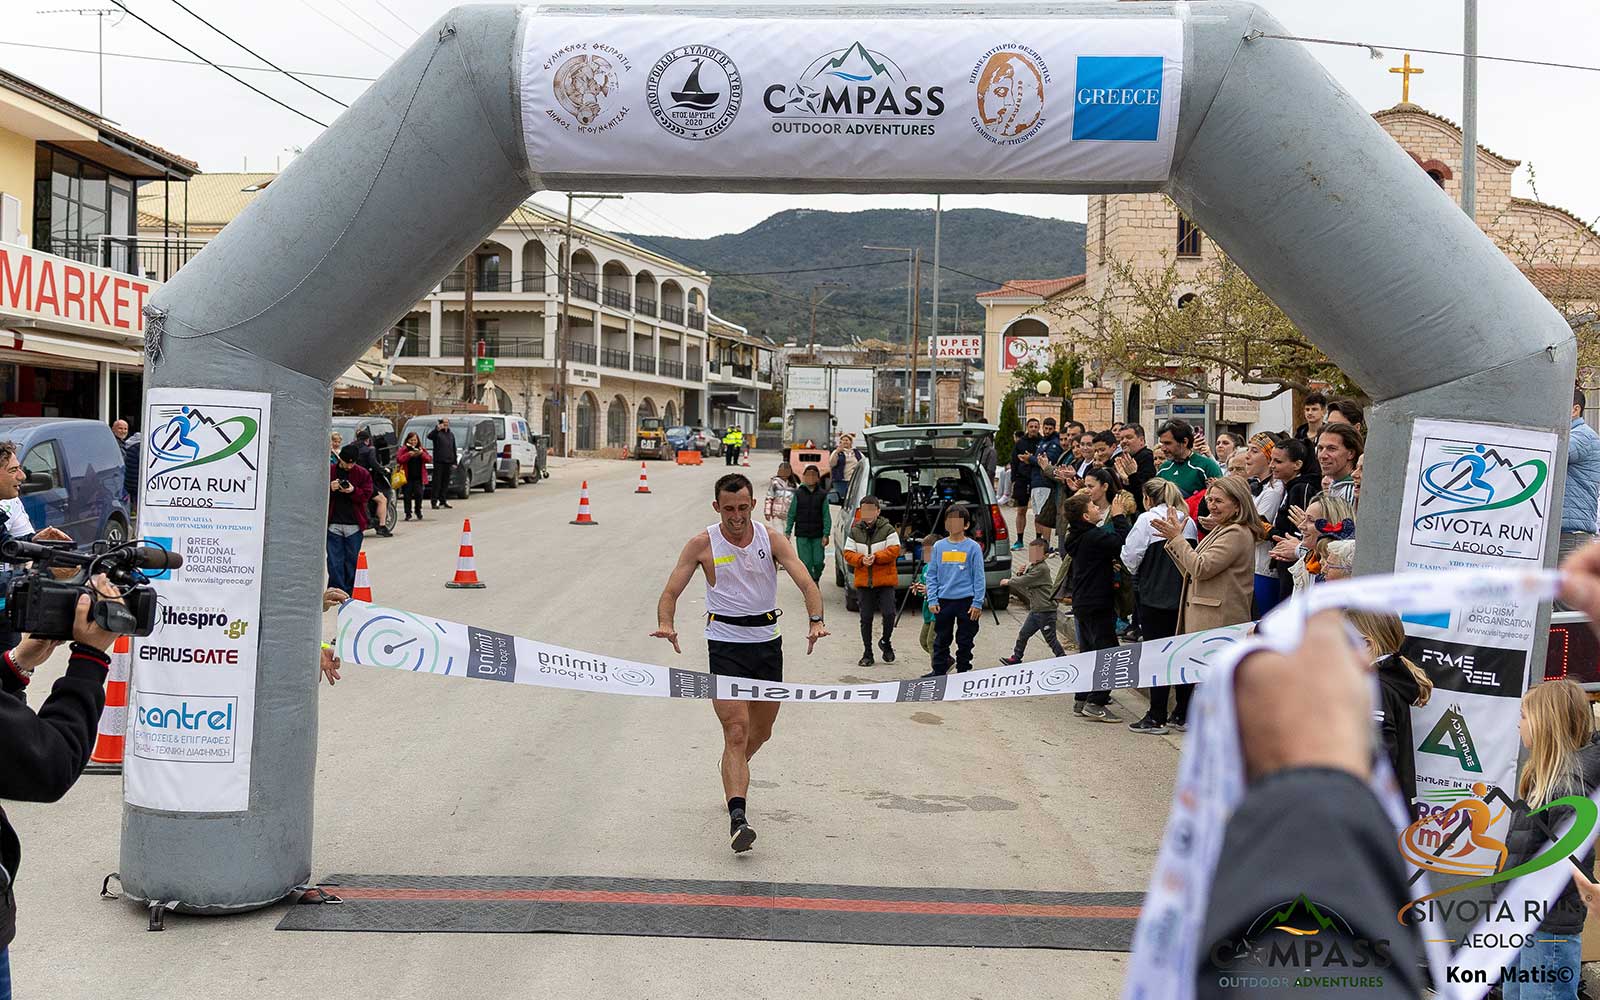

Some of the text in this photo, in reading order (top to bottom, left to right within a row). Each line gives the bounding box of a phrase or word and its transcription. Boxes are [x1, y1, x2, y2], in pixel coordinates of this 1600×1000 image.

[684, 46, 731, 68] ΣΥΛΛΟΓΟΣ
[1077, 88, 1160, 105] GREECE
[546, 109, 571, 130] ΔΗΜΟΣ
[772, 122, 935, 136] OUTDOOR ADVENTURES
[970, 116, 998, 144] CHAMBER
[1008, 118, 1046, 145] THESPROTIA
[0, 249, 149, 331] MARKET
[930, 338, 980, 347] UPER
[640, 439, 656, 449] CAT
[150, 476, 246, 493] SIVOTA RUN
[170, 497, 214, 508] AEOLOS
[1423, 516, 1534, 542] SIVOTA RUN
[187, 537, 220, 546] GREEK
[1452, 541, 1504, 556] AEOLOS
[186, 546, 236, 556] NATIONAL
[186, 555, 232, 564] TOURISM
[186, 564, 255, 574] ORGANISATION
[185, 577, 254, 586] www.visitgreece.gr
[1468, 614, 1532, 628] ORGANISATION
[1422, 649, 1475, 670] FRAME
[1462, 669, 1500, 686] REEL
[139, 702, 232, 730] cantrel
[181, 736, 231, 745] ΕΠΙΓΡΑΦΕΣ
[1450, 718, 1475, 768] ADVENTURE
